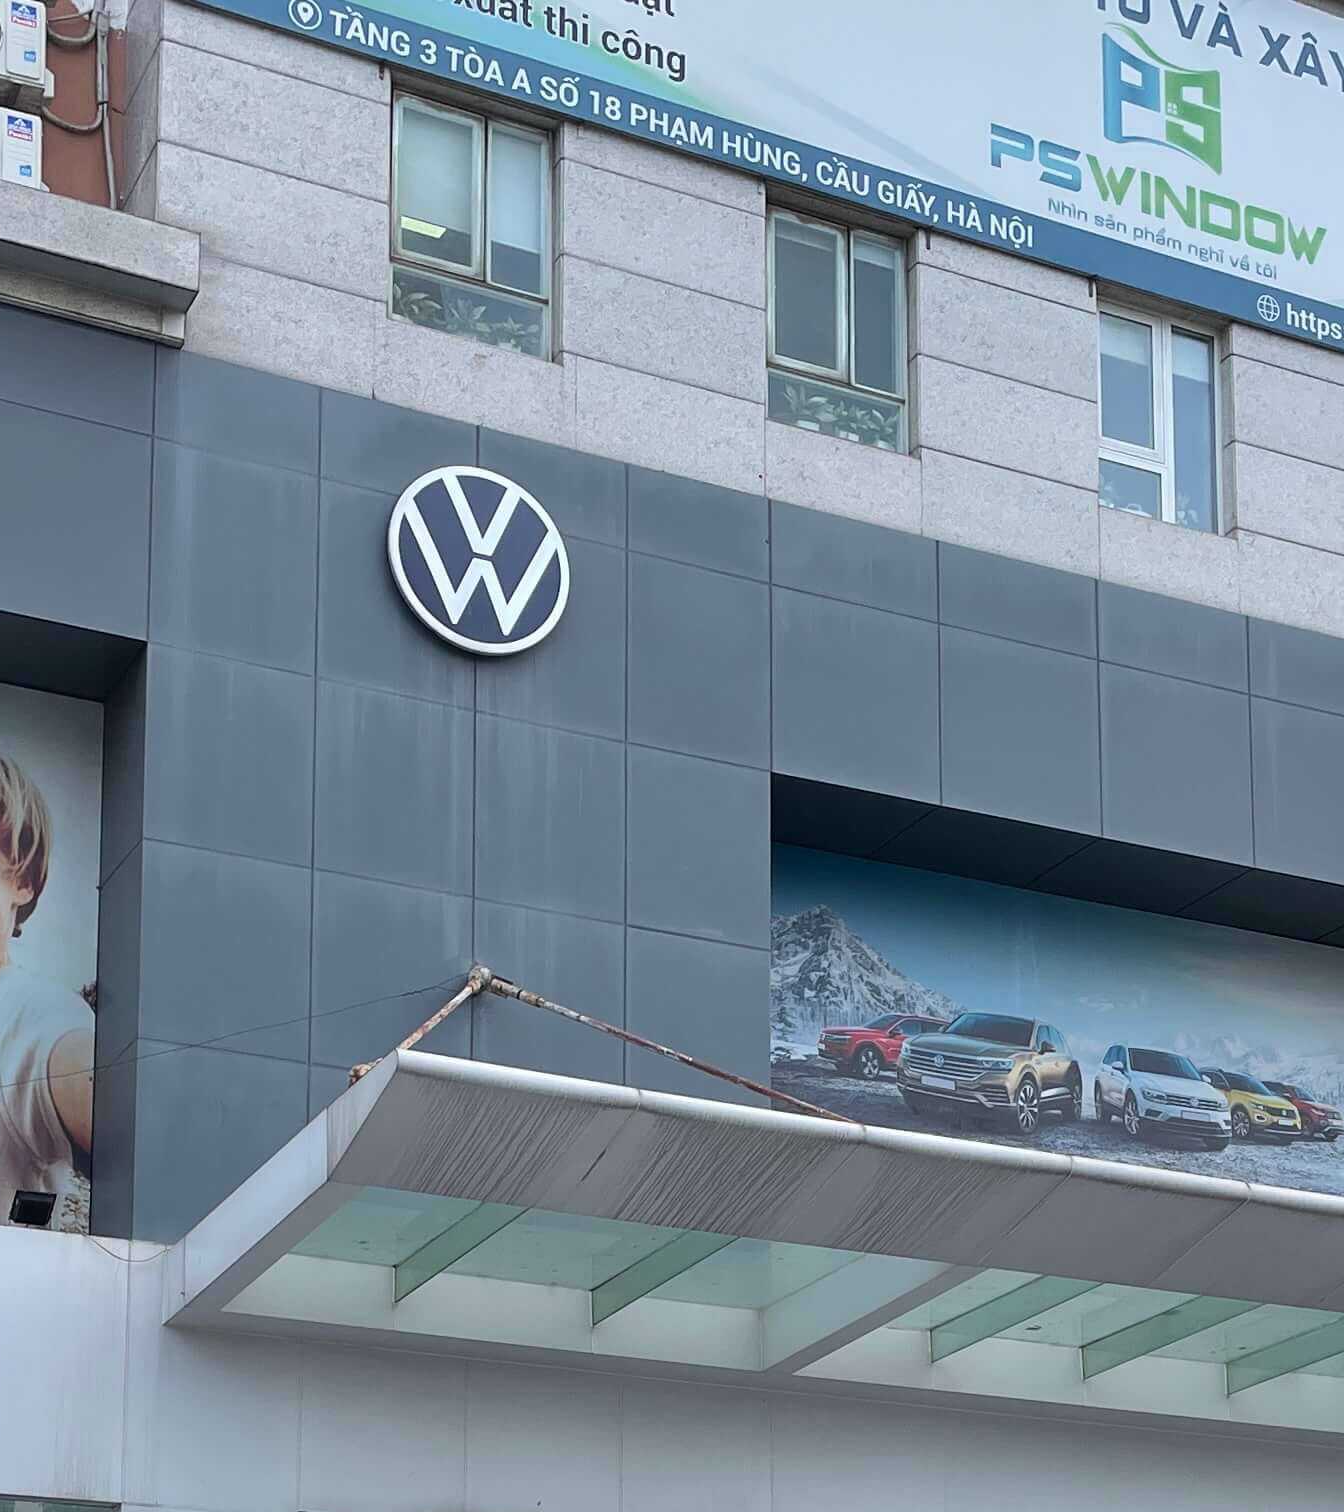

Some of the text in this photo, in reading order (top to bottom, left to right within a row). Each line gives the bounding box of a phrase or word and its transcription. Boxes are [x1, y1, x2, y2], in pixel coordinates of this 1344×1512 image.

[544, 6, 589, 45] thi
[602, 29, 686, 81] công
[1170, 0, 1243, 57] VÀ
[329, 4, 1034, 250] TẦNG 3 TÒA A SỐ 18 PHẠM HÙNG, CẦU GIẤY, HÀ NỘI
[1048, 197, 1088, 224] Nhìn
[1094, 213, 1127, 235] sản
[1256, 260, 1278, 281] tôi
